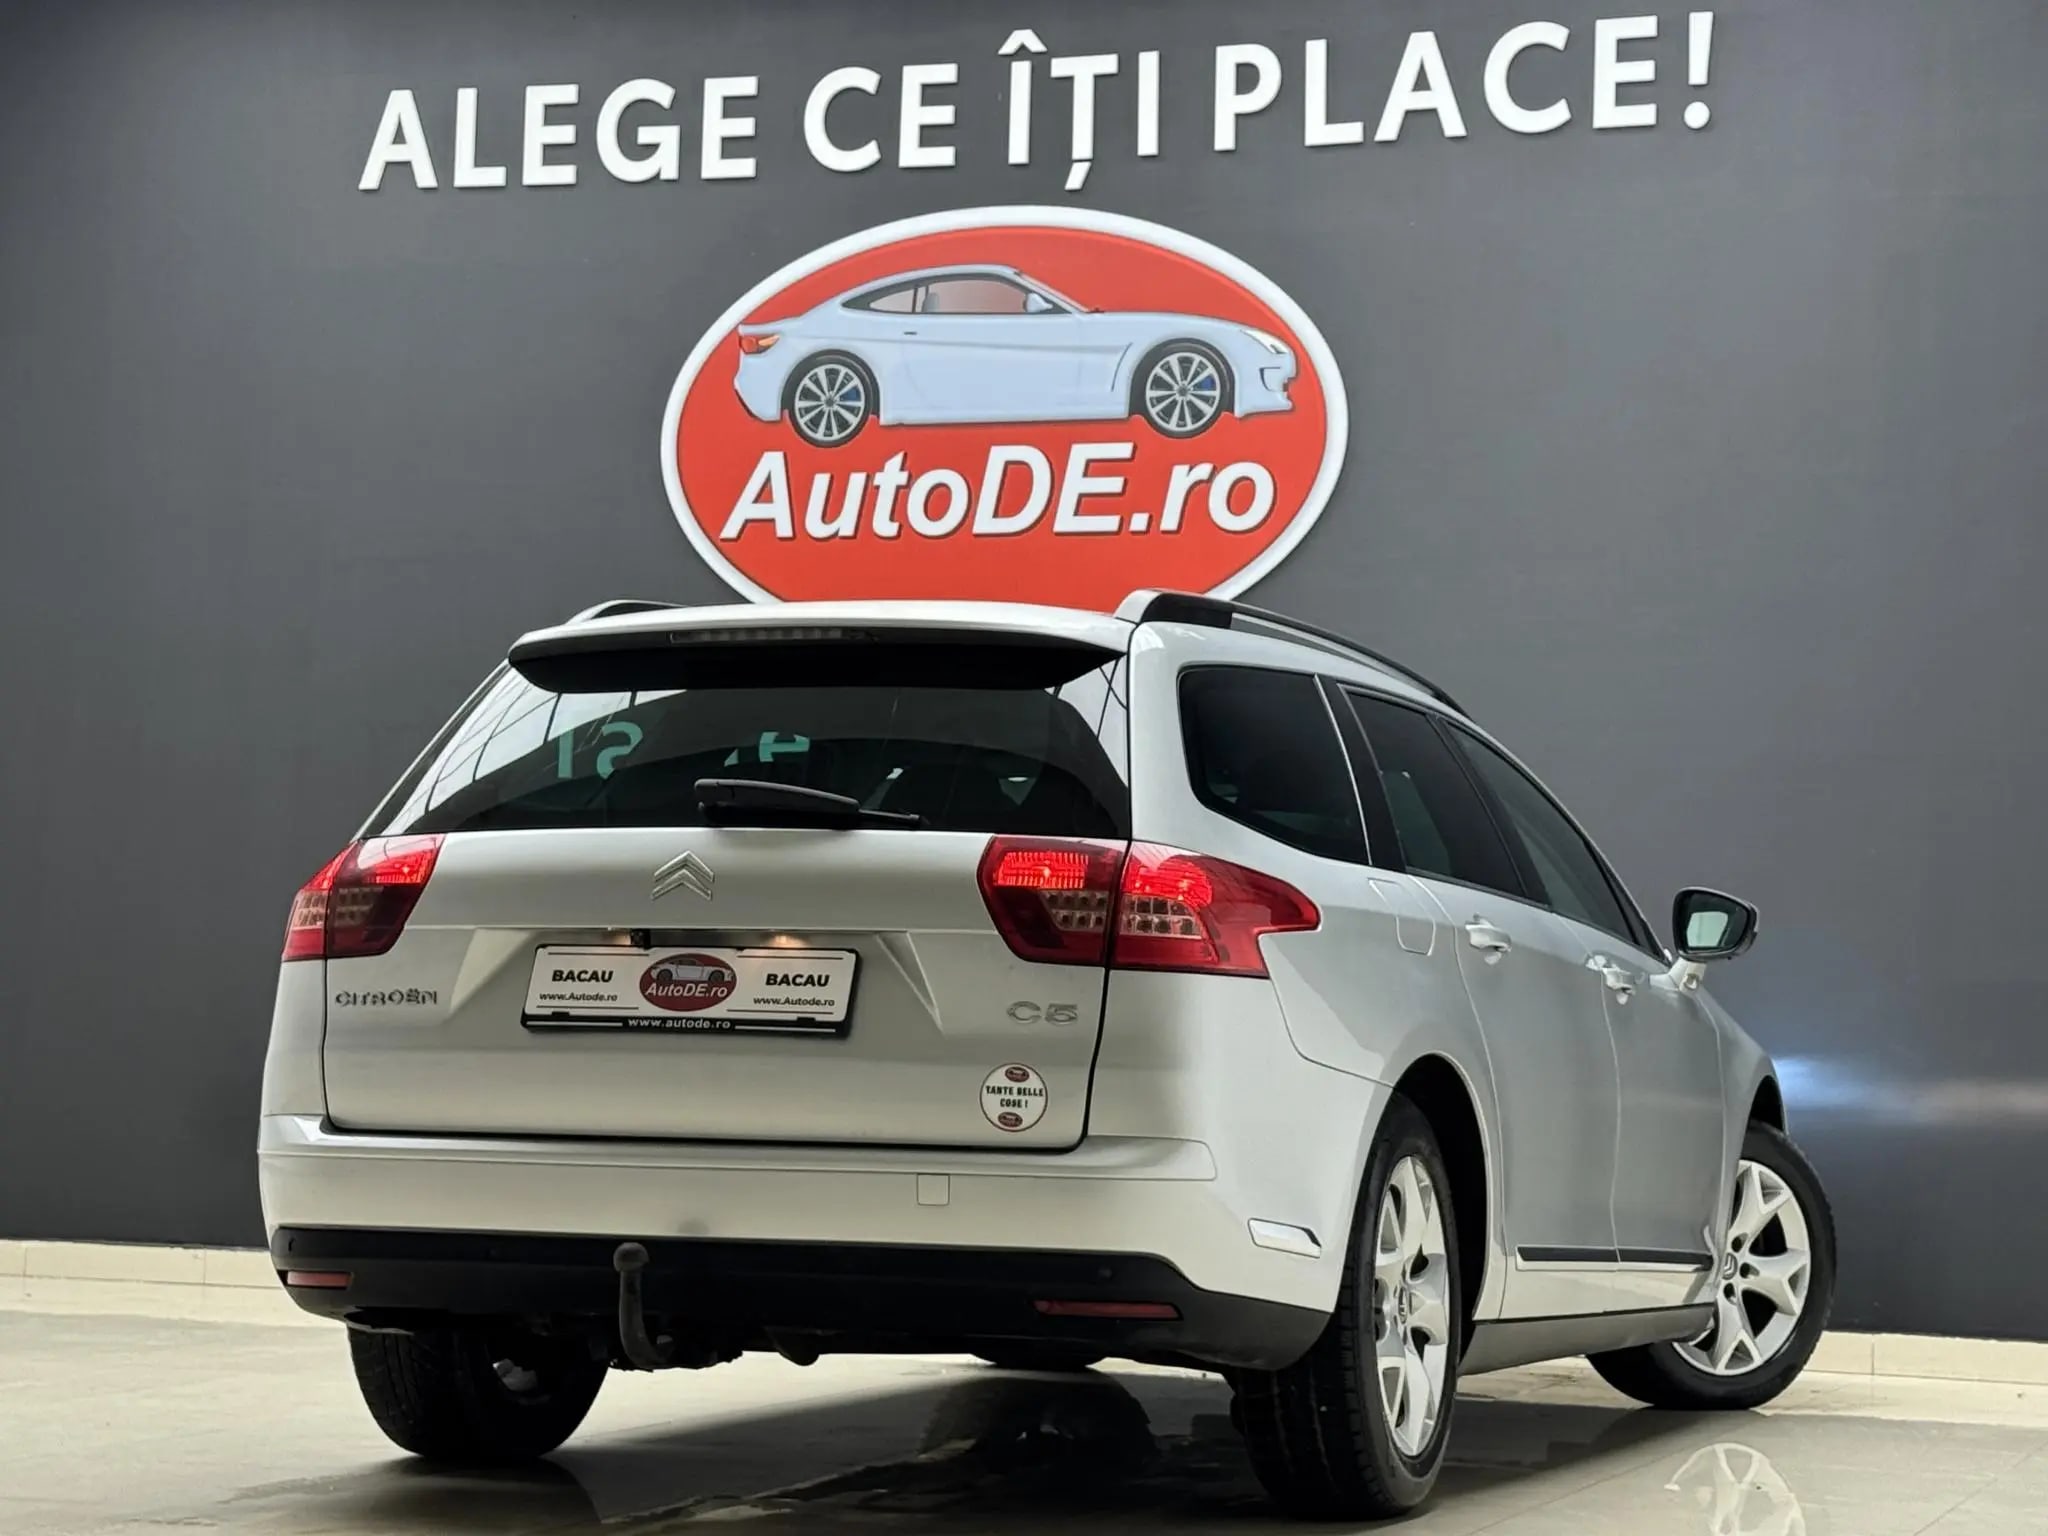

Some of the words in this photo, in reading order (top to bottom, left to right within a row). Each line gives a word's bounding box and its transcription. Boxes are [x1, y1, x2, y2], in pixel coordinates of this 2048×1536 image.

[358, 75, 759, 191] ALEGE
[803, 62, 959, 172] CE
[1213, 10, 1715, 152] PLACE!
[718, 441, 1276, 540] AutoDE.ro
[551, 969, 614, 983] BACAU
[765, 973, 831, 987] BACAU
[335, 987, 438, 1007] CITROËN
[644, 982, 729, 999] AutoDE.ro
[1006, 1000, 1079, 1025] C5
[627, 1017, 732, 1030] www.autode.ro
[985, 1085, 1014, 1096] TANTE
[1016, 1086, 1044, 1097] BELLE
